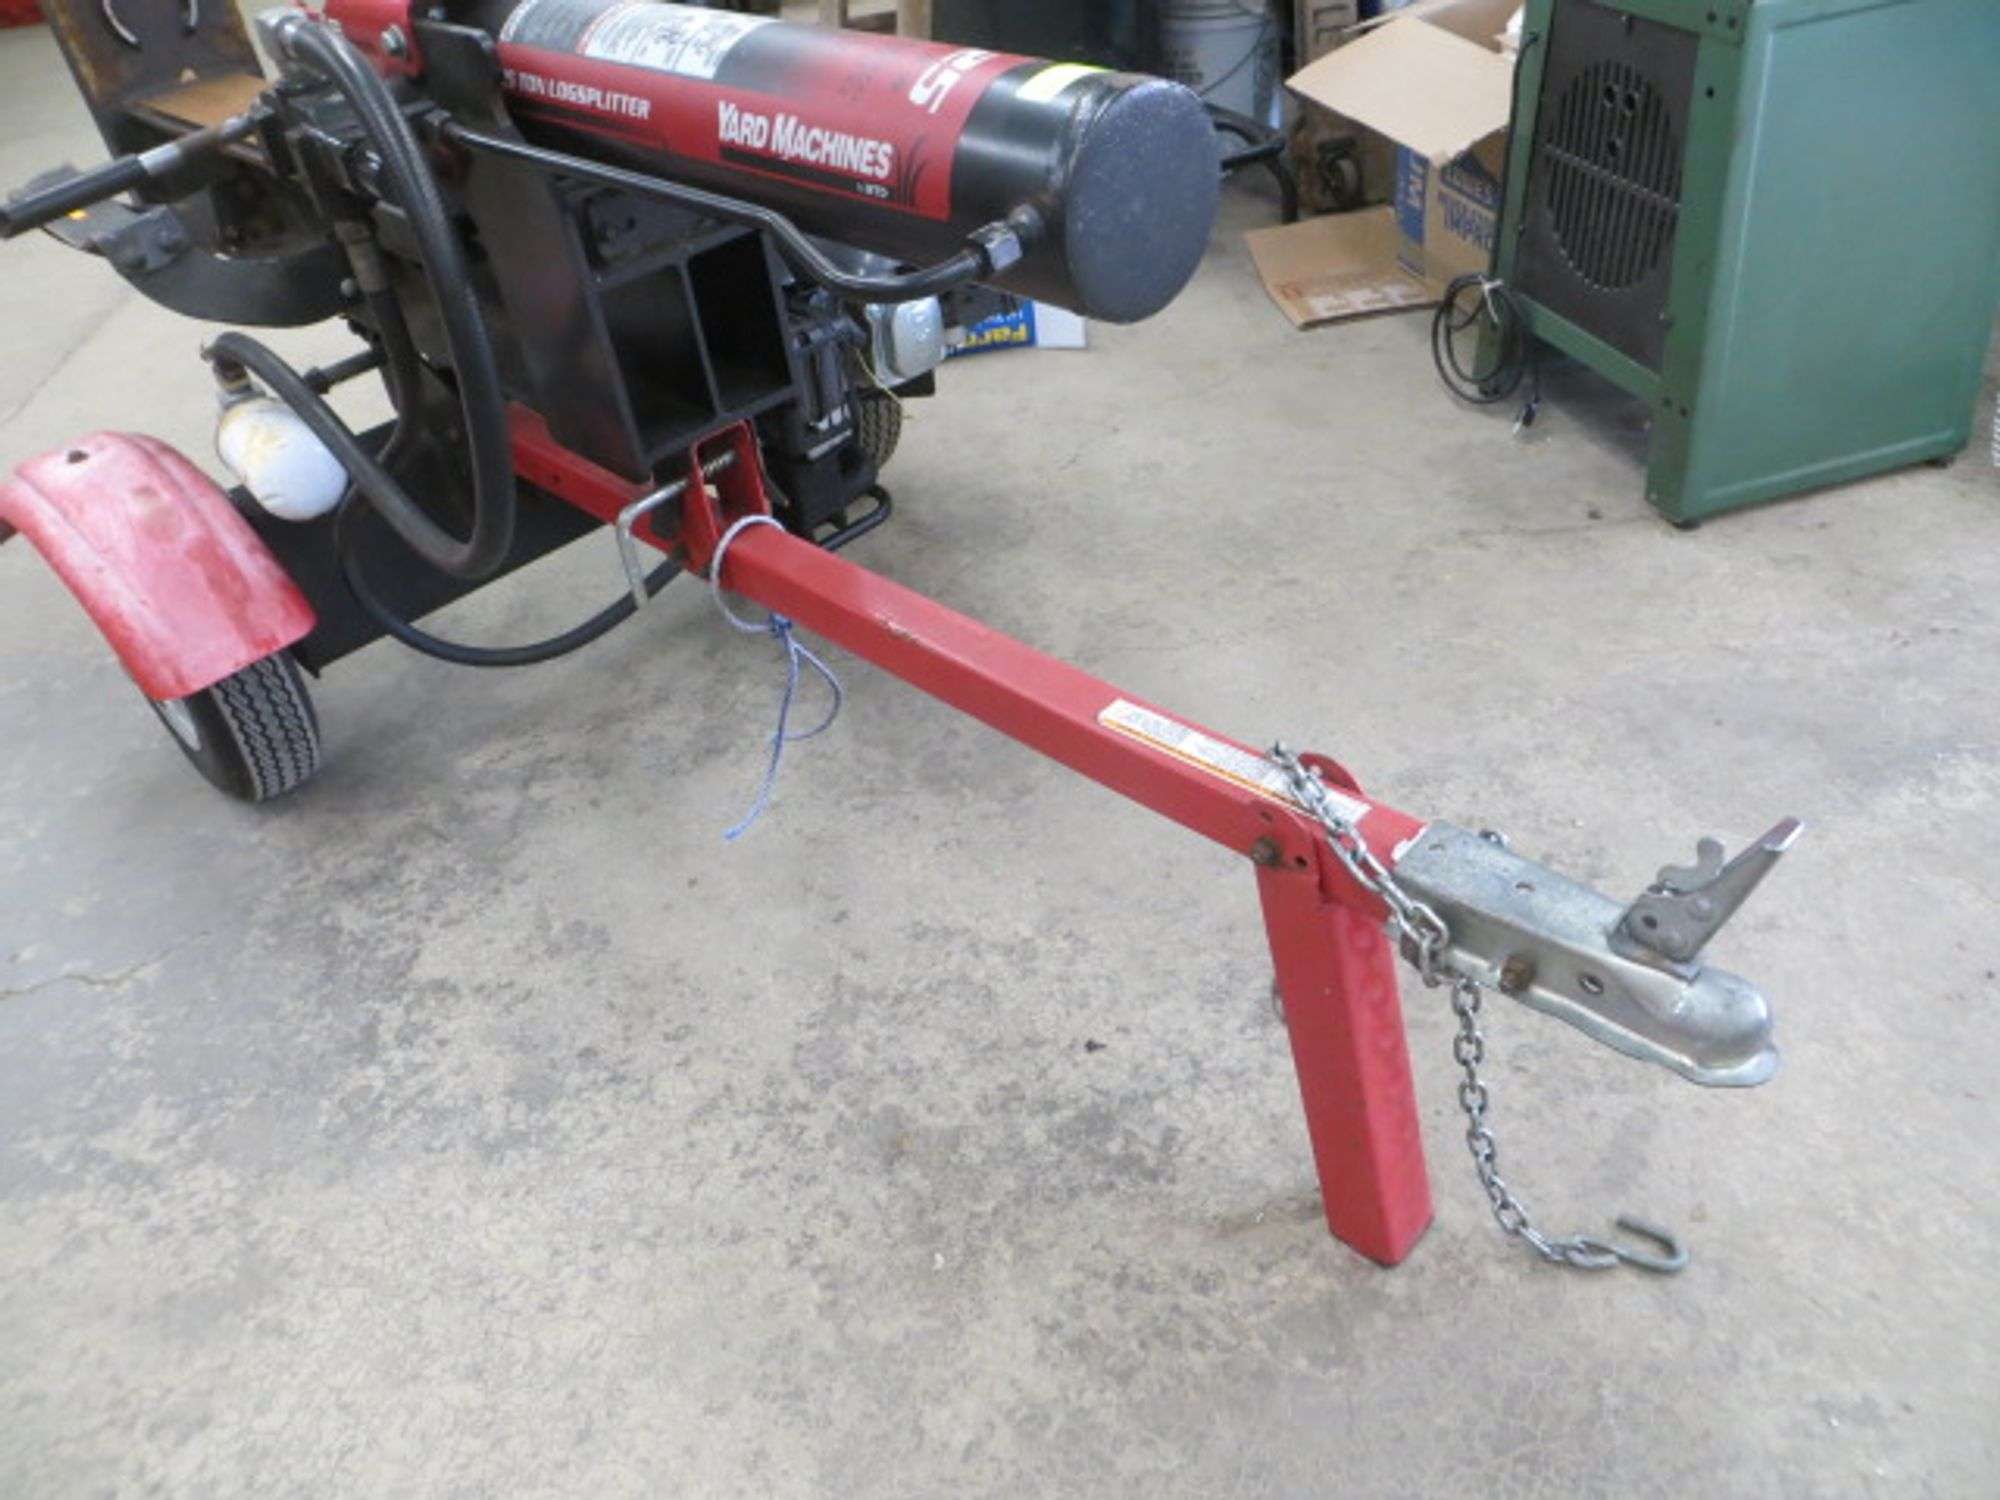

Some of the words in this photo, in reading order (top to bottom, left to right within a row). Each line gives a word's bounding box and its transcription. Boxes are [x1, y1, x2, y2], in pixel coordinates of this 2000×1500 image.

[518, 72, 546, 95] TON
[549, 78, 650, 120] LOGSPLITTER
[718, 100, 770, 149] YARD
[771, 112, 893, 179] MACHINES
